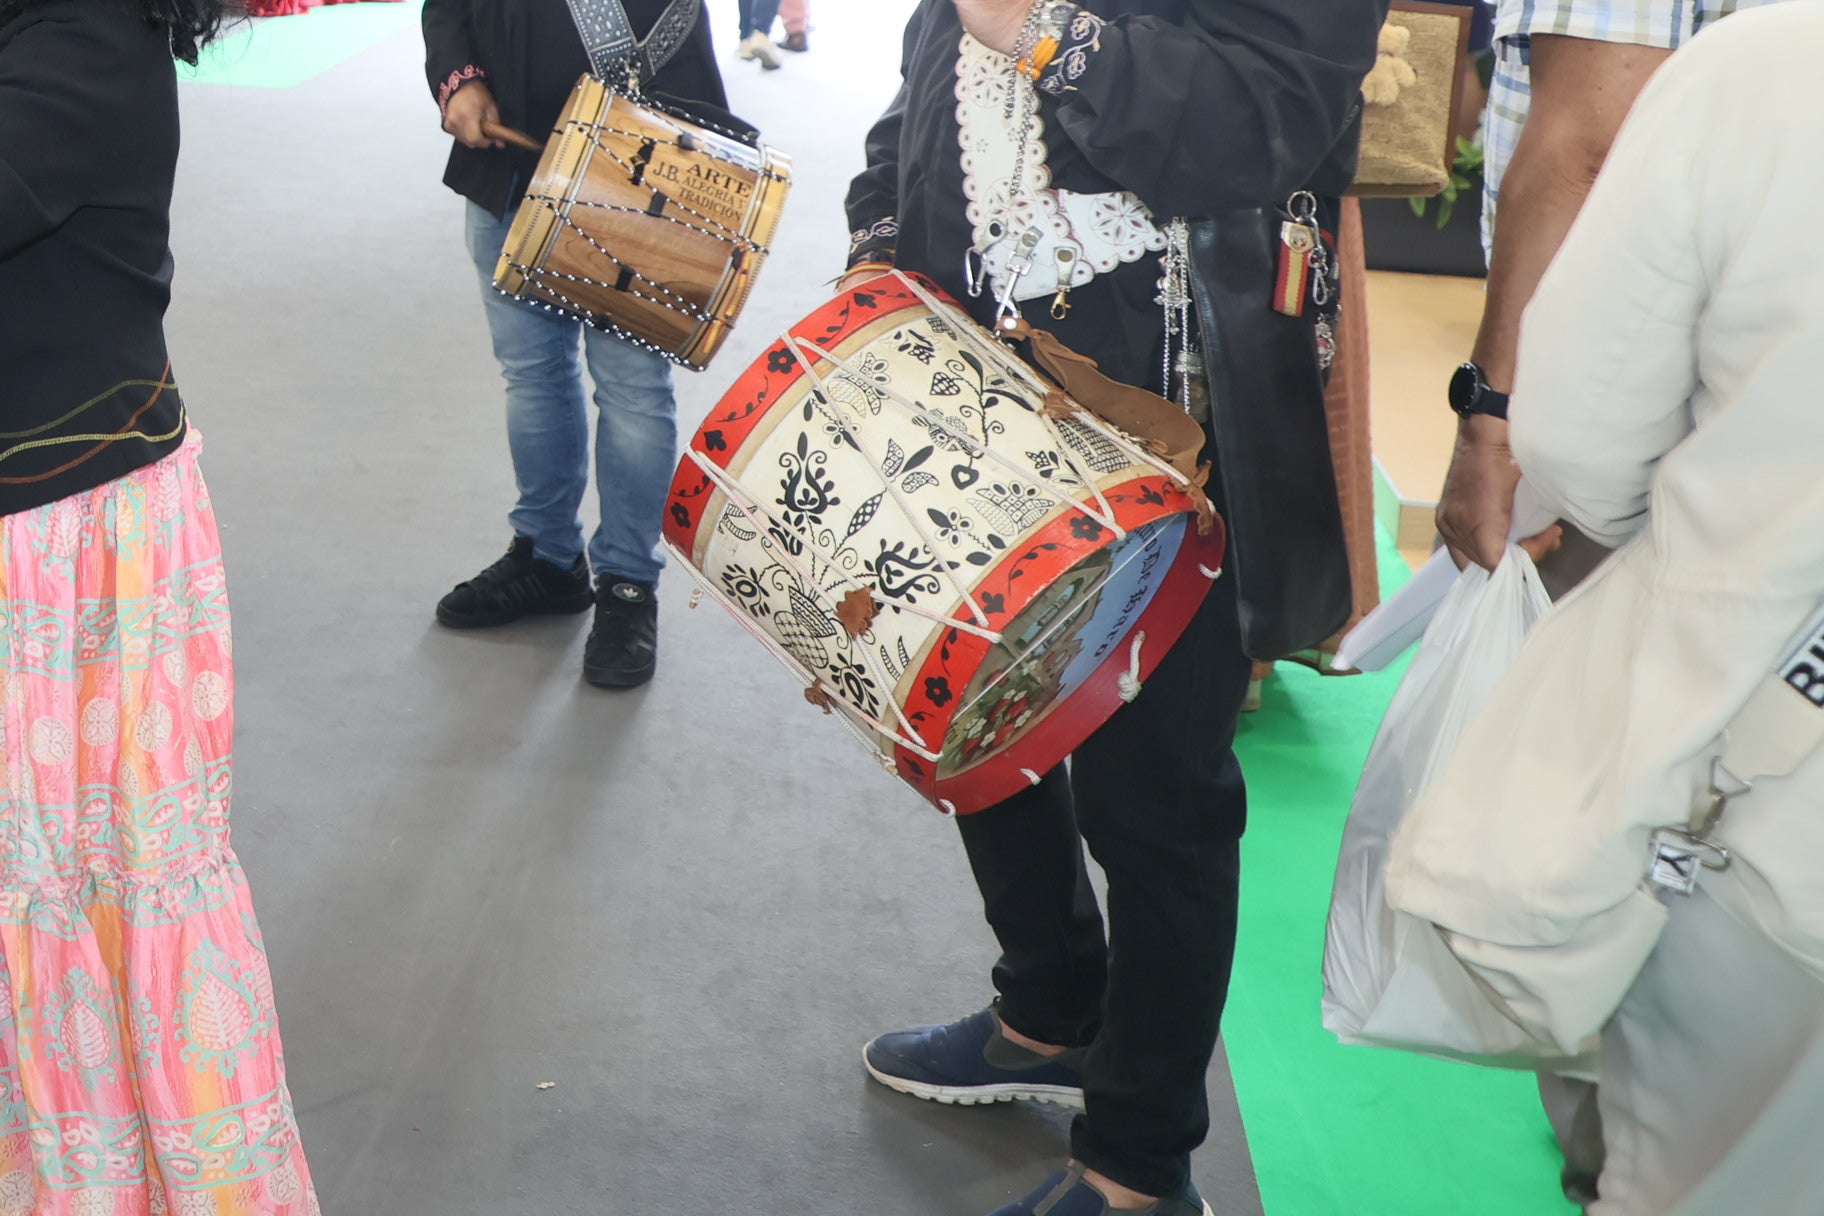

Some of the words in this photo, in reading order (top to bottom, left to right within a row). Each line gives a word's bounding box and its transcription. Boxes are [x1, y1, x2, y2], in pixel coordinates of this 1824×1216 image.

[652, 161, 680, 184] J.B.
[682, 175, 735, 206] ALEGRIA
[686, 163, 752, 198] ARTE
